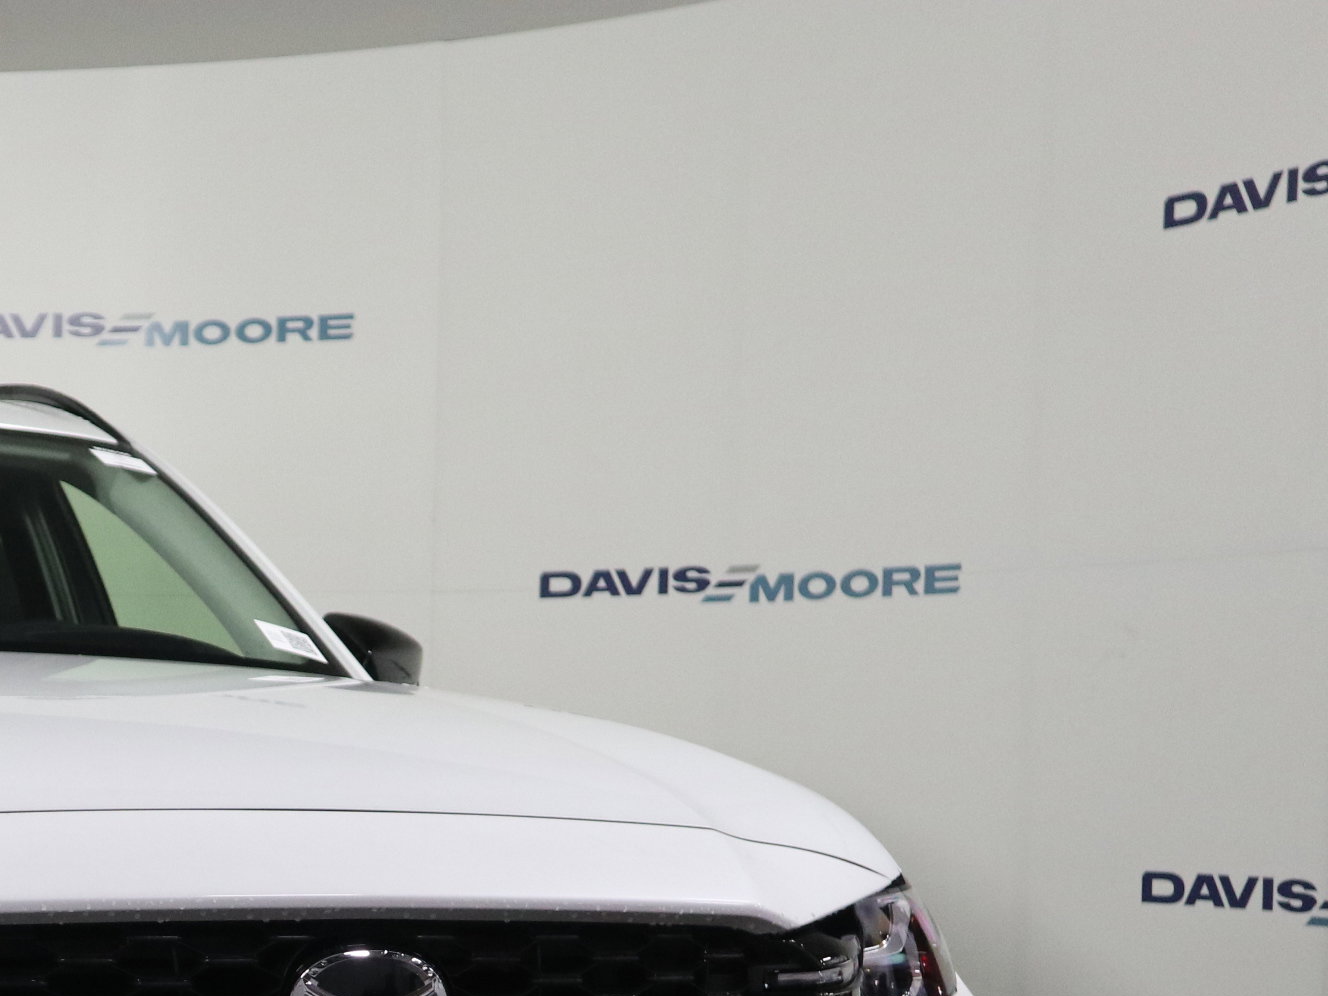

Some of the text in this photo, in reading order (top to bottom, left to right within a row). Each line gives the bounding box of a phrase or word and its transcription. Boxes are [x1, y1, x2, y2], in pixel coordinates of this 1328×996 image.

[1162, 158, 1328, 232] DAVIS
[145, 312, 356, 347] MOORE
[538, 562, 963, 605] DAVIS MOORE
[1140, 870, 1318, 915] DAVIS
